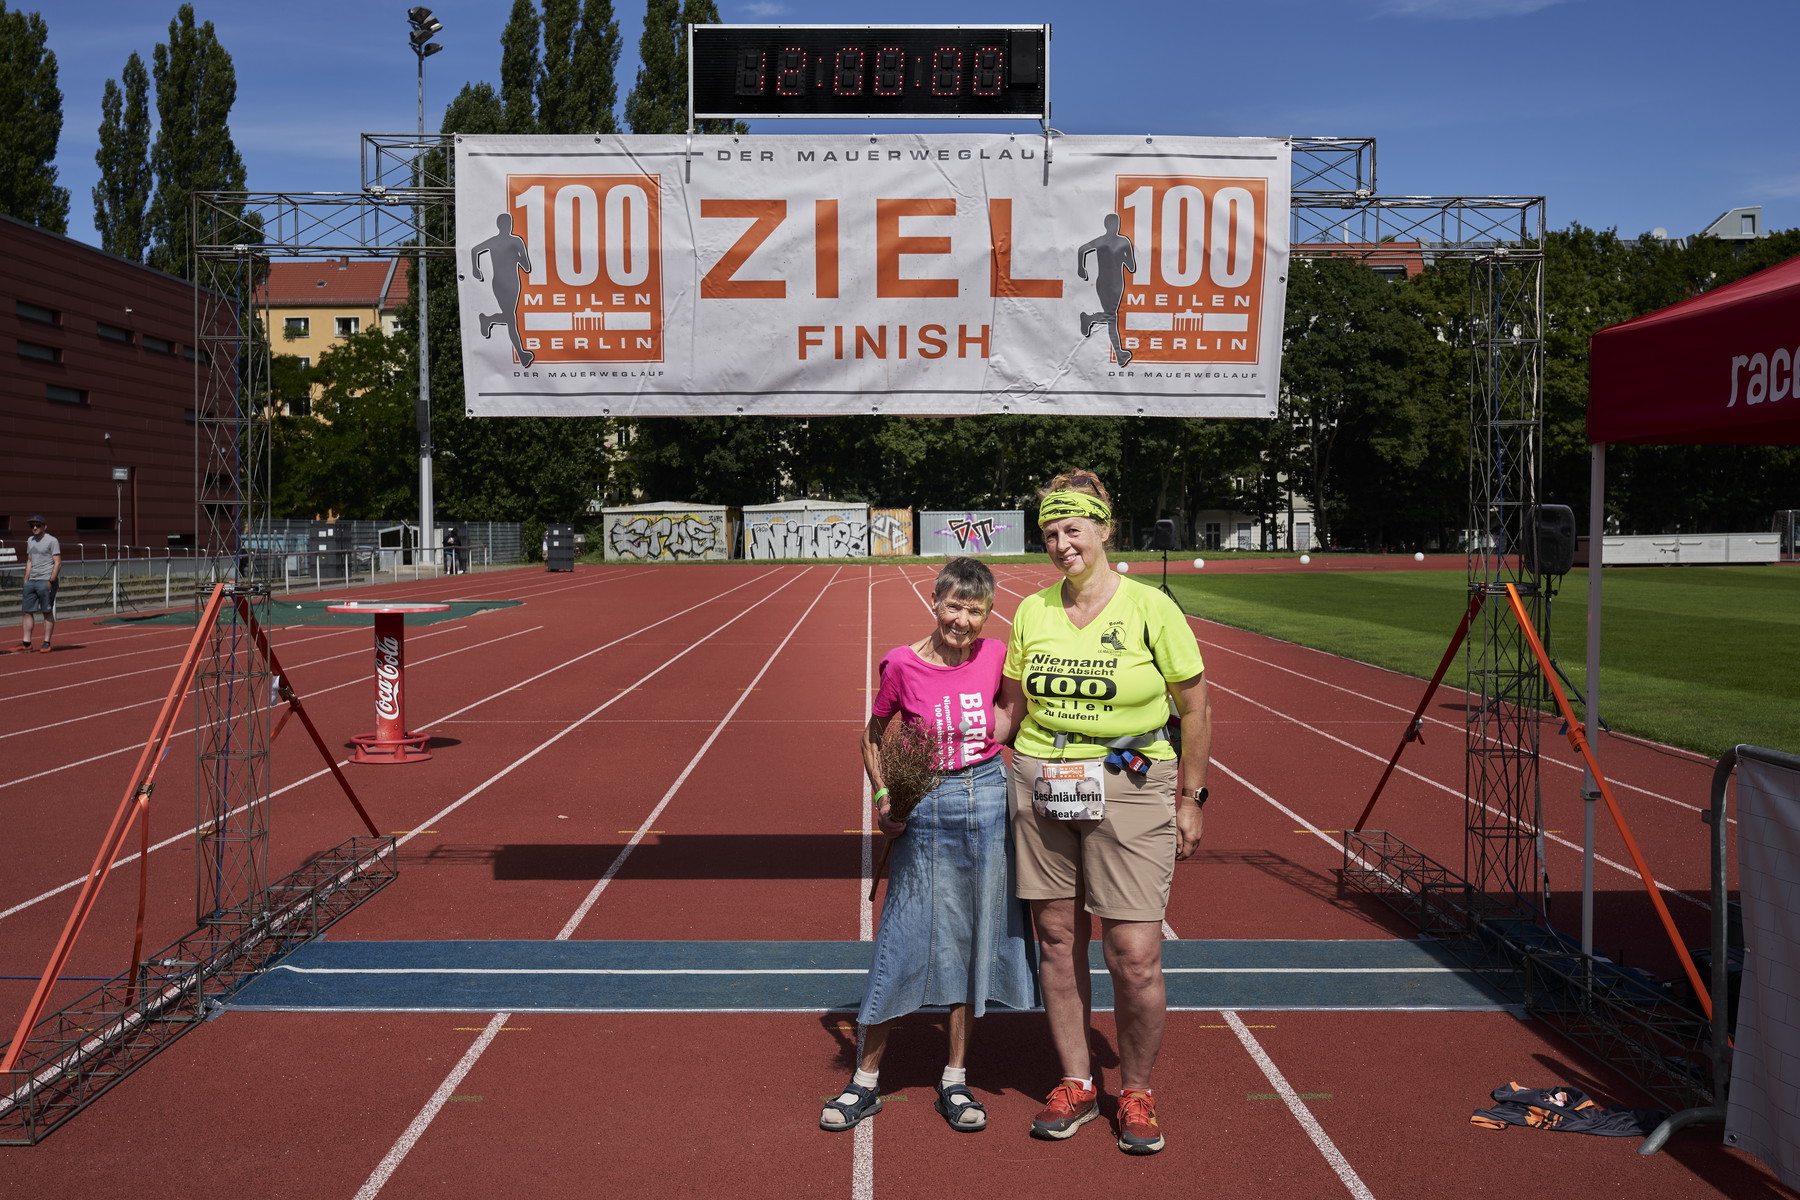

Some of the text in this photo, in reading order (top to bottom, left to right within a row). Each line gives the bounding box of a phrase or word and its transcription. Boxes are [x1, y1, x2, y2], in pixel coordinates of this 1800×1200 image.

[759, 46, 1003, 96] 12:00:00
[717, 149, 775, 163] DER
[514, 184, 650, 287] 100
[1123, 185, 1255, 288] 100
[700, 198, 1064, 299] ZIEL
[523, 293, 652, 306] MEILEN
[1126, 294, 1251, 307] MEILEN
[525, 337, 653, 350] BERLIN
[798, 324, 990, 361] FINISH
[1124, 337, 1248, 351] BERLIN
[513, 371, 539, 379] DER
[1031, 653, 1118, 668] Niemand
[1067, 668, 1115, 676] Absicht
[1030, 675, 1107, 697] 100
[934, 703, 943, 717] 100
[943, 696, 955, 731] Niemand
[1044, 709, 1099, 721] zu laufen!
[960, 692, 987, 766] BERLI
[1034, 790, 1102, 802] Besenläuferin
[1051, 809, 1080, 818] Beate
